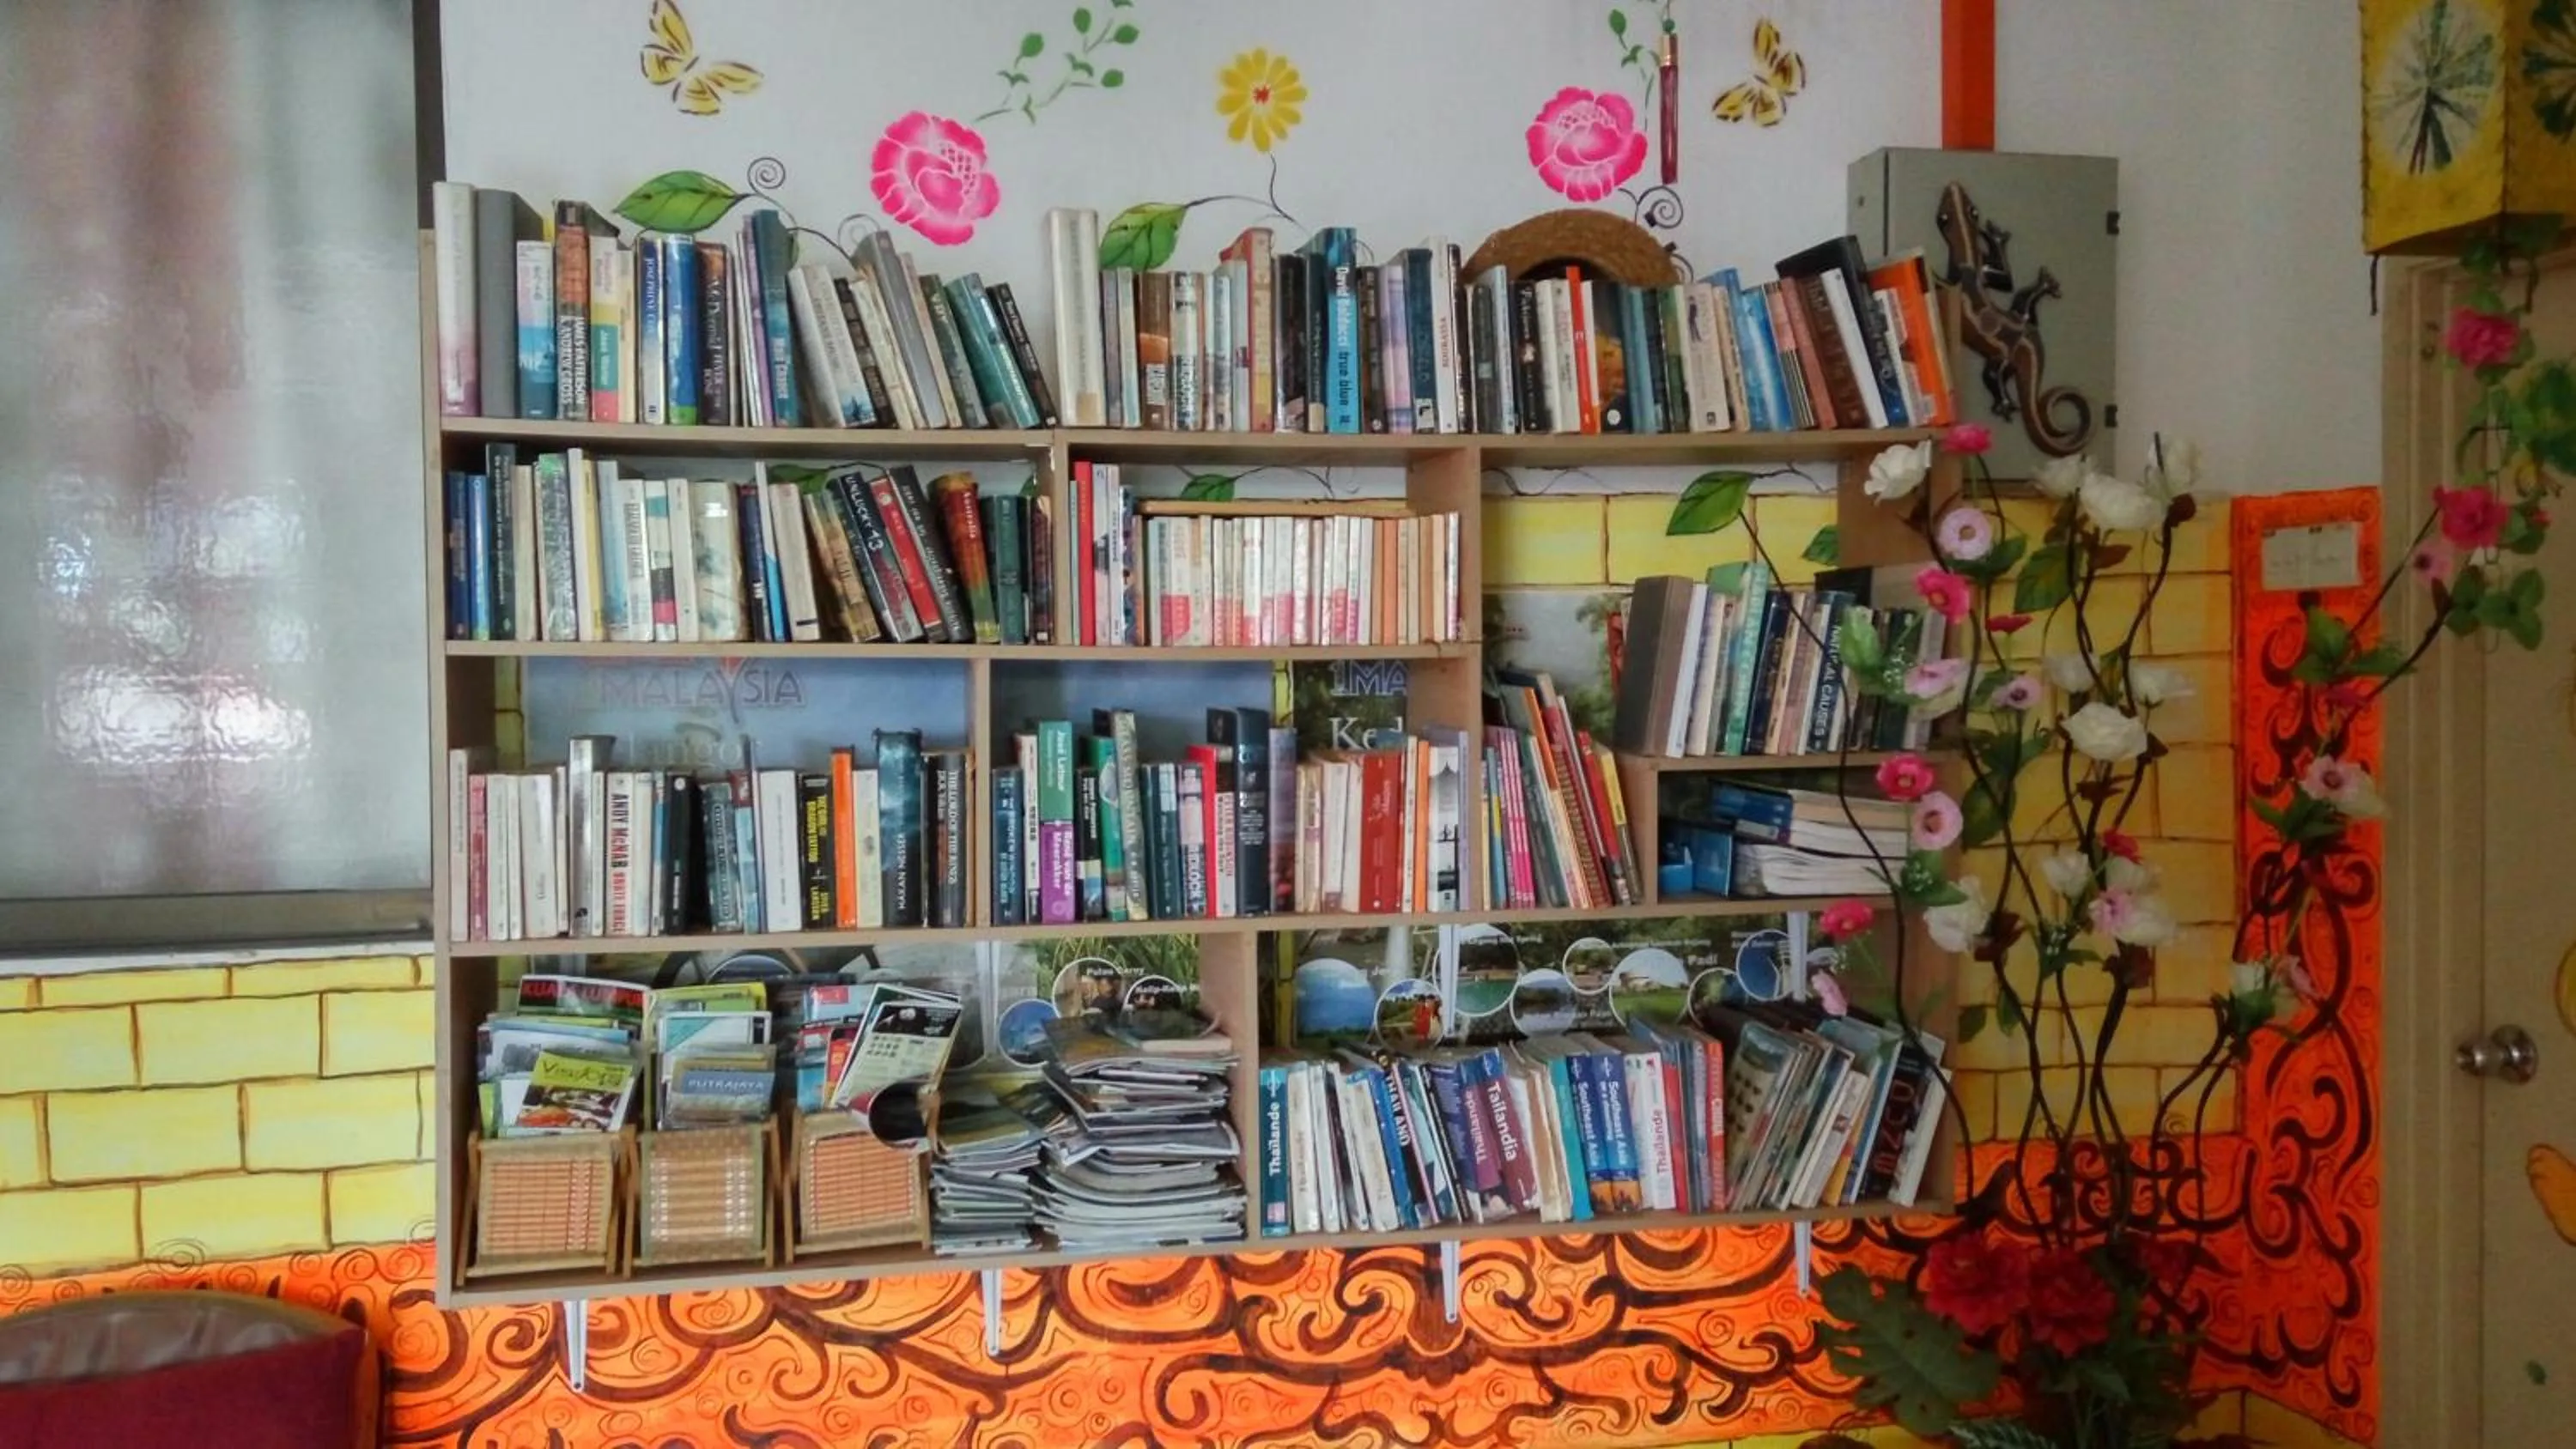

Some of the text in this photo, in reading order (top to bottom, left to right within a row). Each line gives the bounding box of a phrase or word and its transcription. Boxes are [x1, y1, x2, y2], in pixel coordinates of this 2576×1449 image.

[560, 326, 573, 367] ANDREW
[574, 316, 586, 404] JAMES PATTERSON
[1335, 267, 1352, 405] David Baldacci true blue
[561, 370, 574, 404] CROSS
[844, 476, 884, 551] UNLUCKY 13
[963, 491, 977, 539] Australia
[1814, 684, 1832, 737] CAUSES
[611, 794, 629, 823] ANDY
[611, 828, 629, 868] McNAB
[687, 1078, 764, 1091] PUTRAJAYA
[1385, 1075, 1410, 1147] THAILAND
[1486, 1082, 1518, 1161] Tailandia
[1578, 1082, 1599, 1167] Southeast Asia
[1608, 1081, 1627, 1165] Southeast Asia
